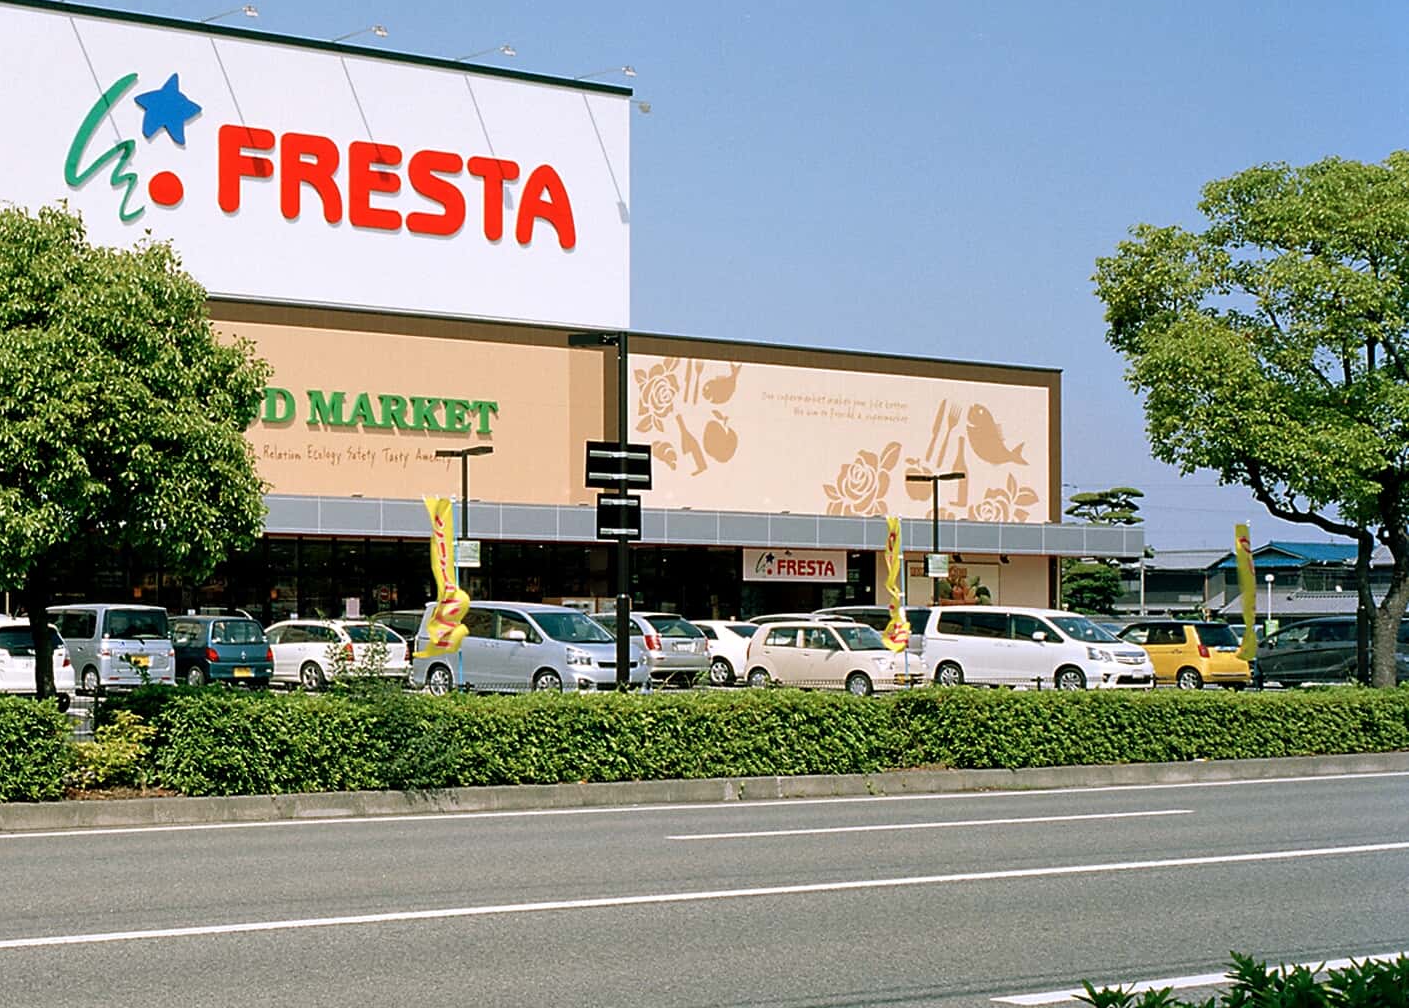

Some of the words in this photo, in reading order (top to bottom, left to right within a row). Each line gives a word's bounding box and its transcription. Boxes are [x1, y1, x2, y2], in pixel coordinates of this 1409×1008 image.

[218, 124, 577, 249] FRESTA
[306, 390, 499, 434] MARKET
[777, 559, 835, 577] FRESTA
